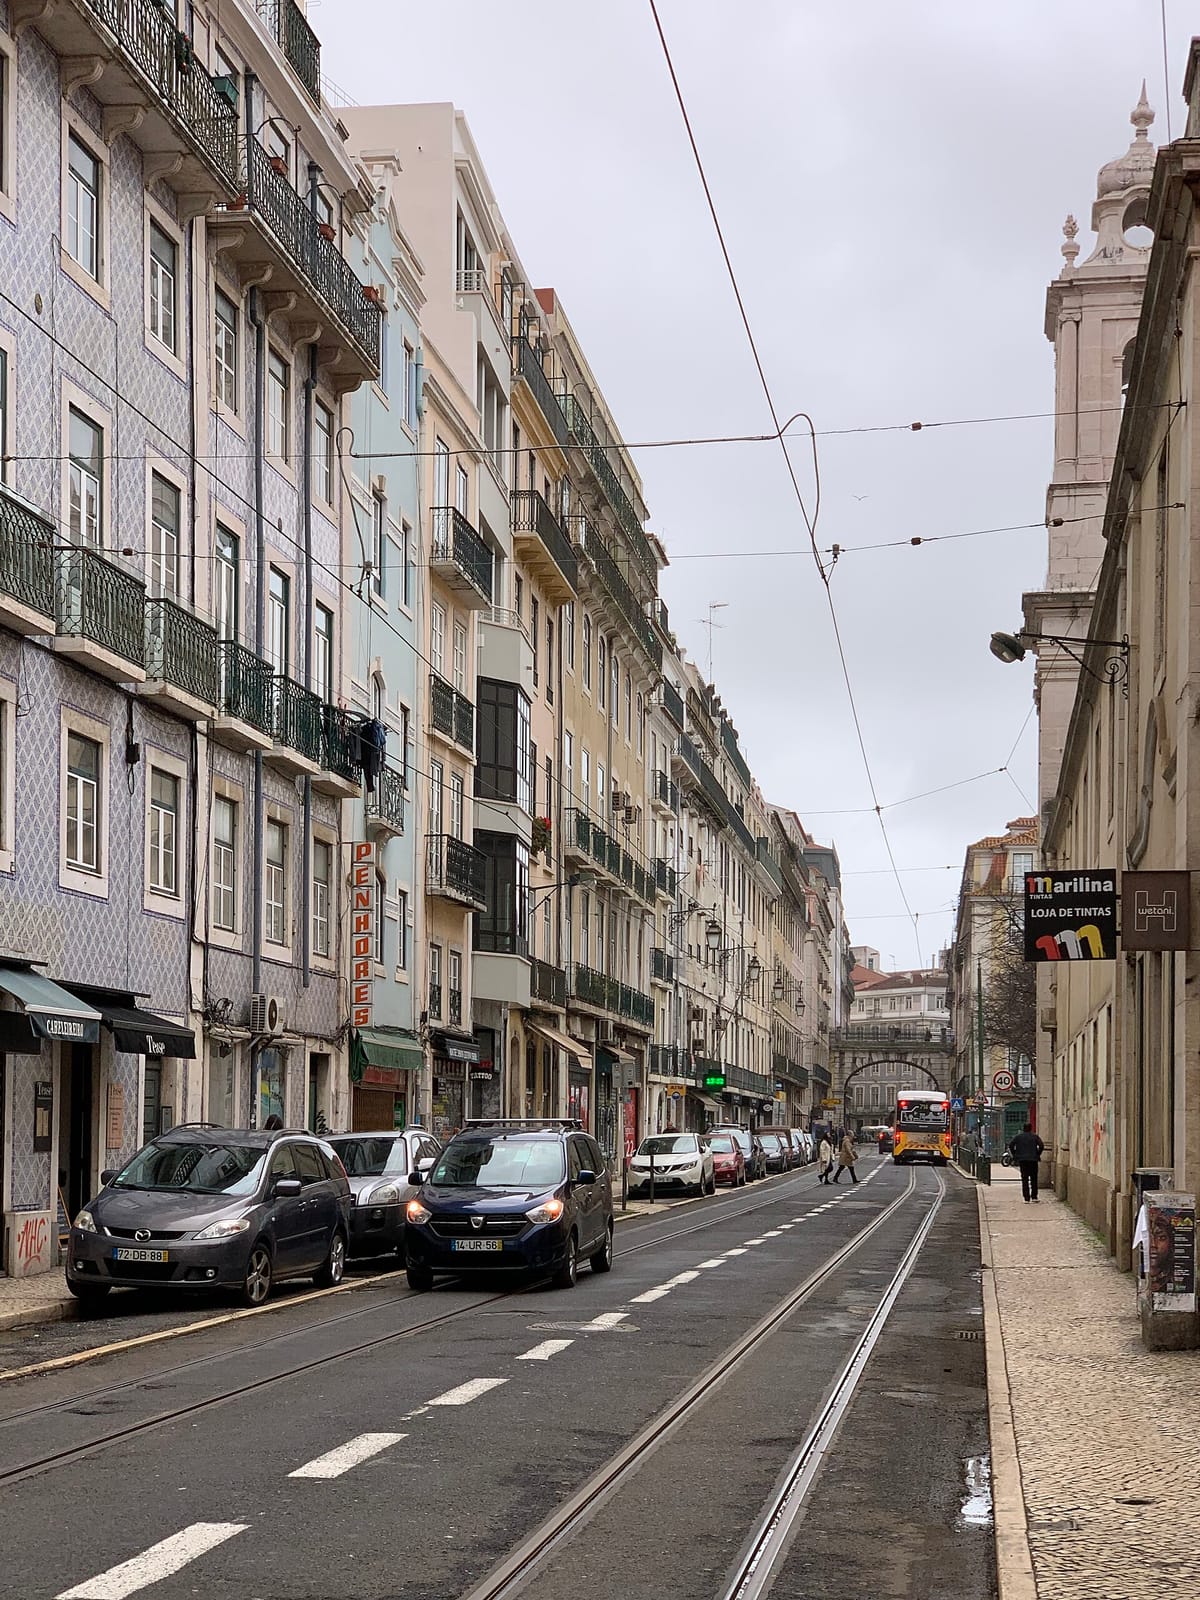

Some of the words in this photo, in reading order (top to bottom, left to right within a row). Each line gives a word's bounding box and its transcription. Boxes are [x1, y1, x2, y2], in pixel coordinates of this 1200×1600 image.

[1027, 876, 1114, 893] marilina
[1031, 908, 1057, 918] LOJA
[1059, 908, 1073, 917] DE
[1074, 907, 1112, 916] TINTAS
[354, 842, 372, 1026] PENHORES
[146, 1035, 165, 1055] Tease
[470, 1072, 492, 1080] TATTOO
[996, 1077, 1010, 1085] 40
